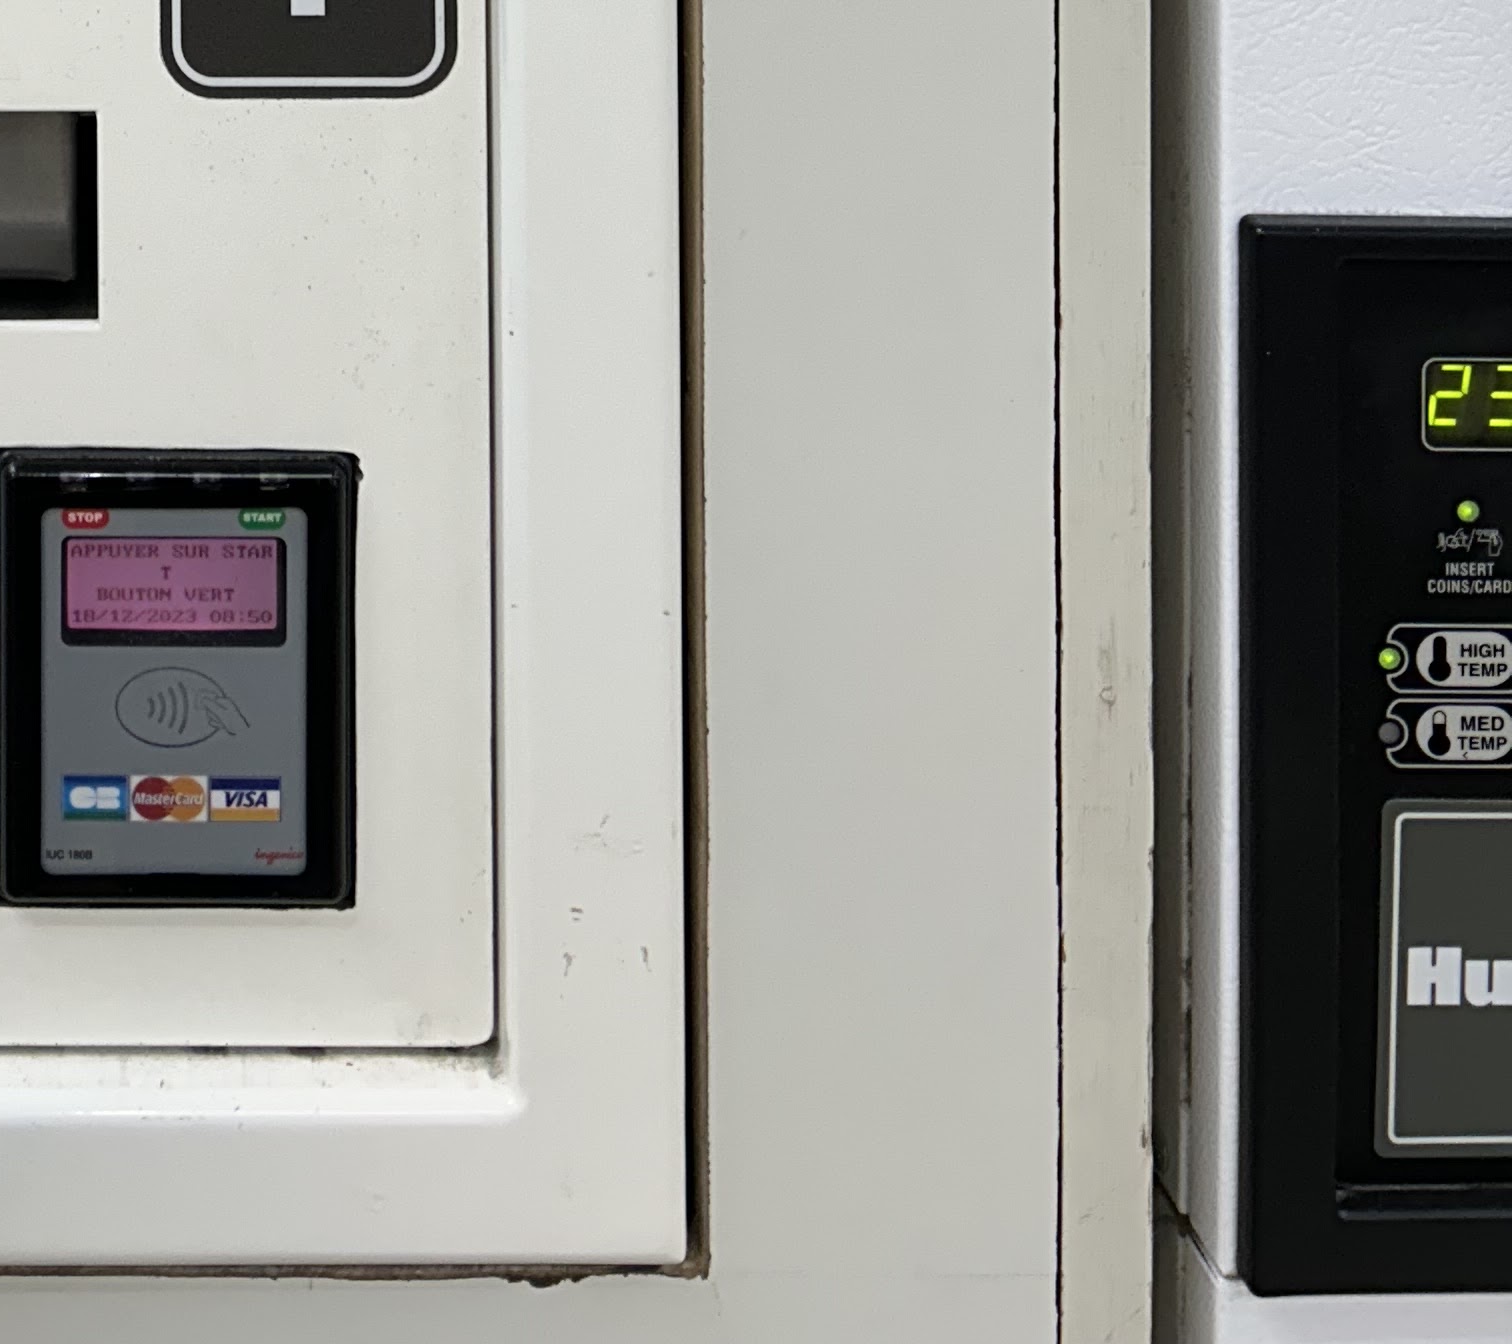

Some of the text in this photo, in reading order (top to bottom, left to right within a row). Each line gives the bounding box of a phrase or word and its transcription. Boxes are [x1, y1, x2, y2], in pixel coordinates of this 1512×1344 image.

[67, 512, 104, 524] STOP
[242, 512, 282, 524] START
[70, 544, 273, 559] APPUYER SUR STAR
[160, 566, 172, 580] T
[1445, 562, 1495, 577] INSERT
[97, 587, 235, 602] BOUTON VERT
[72, 610, 273, 624] 18/12/2023 08:50
[1459, 643, 1506, 658] HIGH
[1457, 662, 1508, 677] TEMP
[1460, 715, 1505, 731] MED
[1457, 736, 1508, 751] TEMP
[133, 791, 204, 808] MasterCard
[224, 791, 268, 808] VISA
